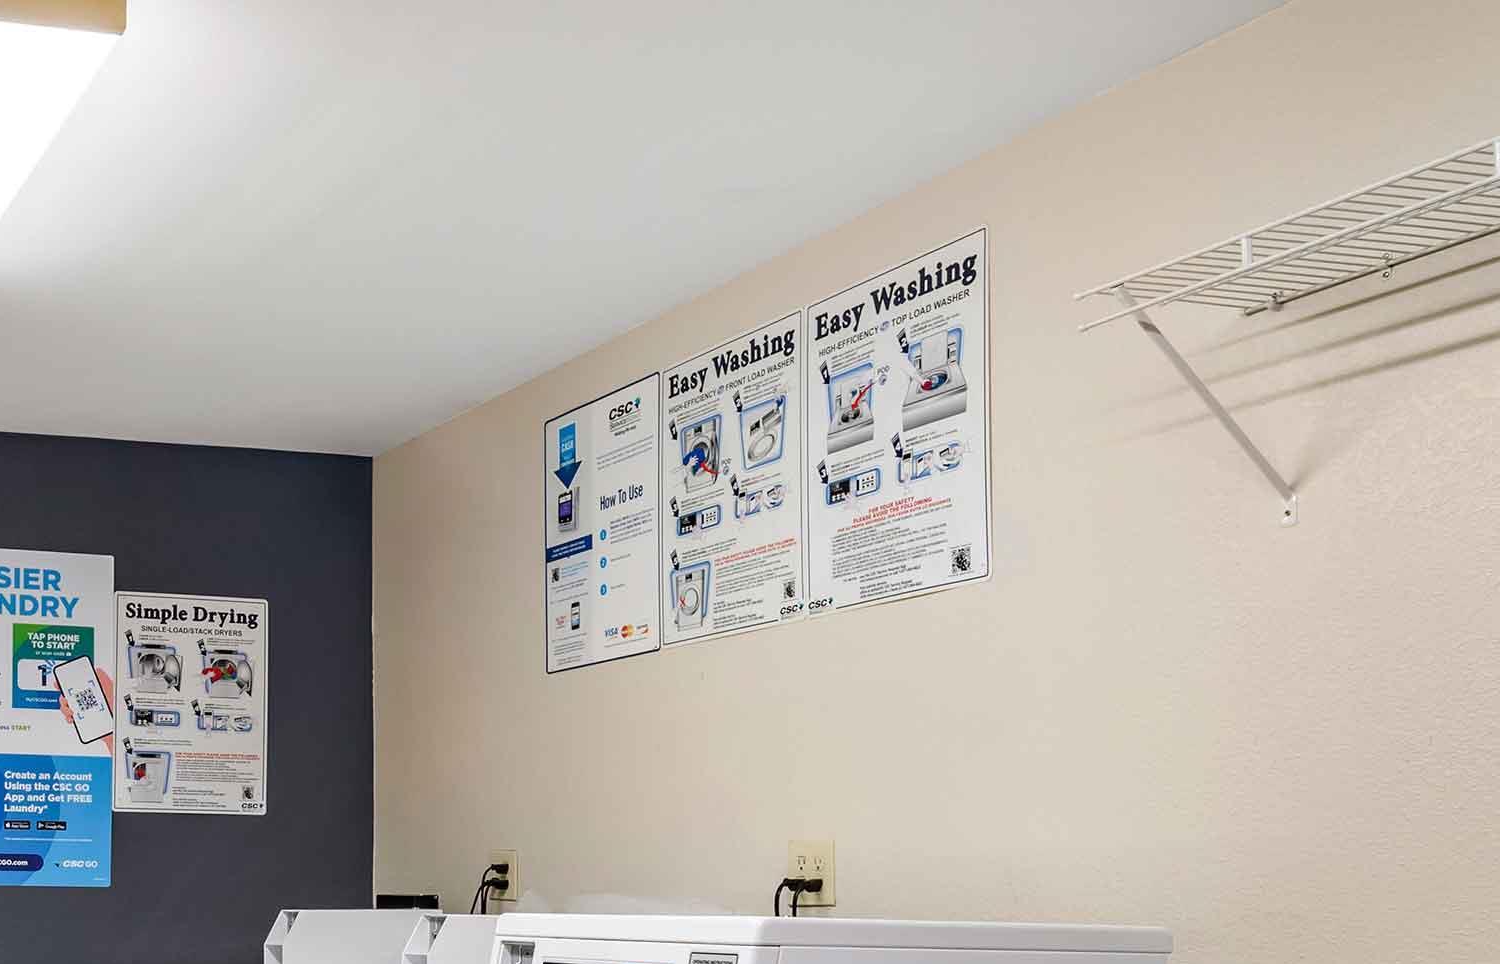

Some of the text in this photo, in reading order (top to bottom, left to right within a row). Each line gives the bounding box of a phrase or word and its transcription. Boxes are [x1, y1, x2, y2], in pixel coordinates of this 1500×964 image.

[815, 254, 977, 341] Easy Washing
[819, 288, 970, 357] HIGH-EFFICIENCY TOP LOAD WASHER
[669, 329, 795, 399] Easy Washing
[669, 357, 795, 415] HIGH-EFFICIENCY FRONT LOAD WASHER
[609, 401, 633, 420] CSC
[600, 484, 643, 511] How To Use
[780, 604, 798, 615] CSC
[808, 599, 828, 610] CSC
[126, 602, 258, 629] Simple Drying
[28, 632, 80, 642] TAP PHONE
[31, 641, 76, 650] TO START
[37, 664, 47, 686] 1
[4, 771, 92, 781] Create an Account
[4, 781, 32, 791] Using
[34, 782, 50, 791] the
[52, 783, 72, 791] CSC
[4, 793, 92, 803] App and Get FREE
[62, 860, 98, 869] CSC GO
